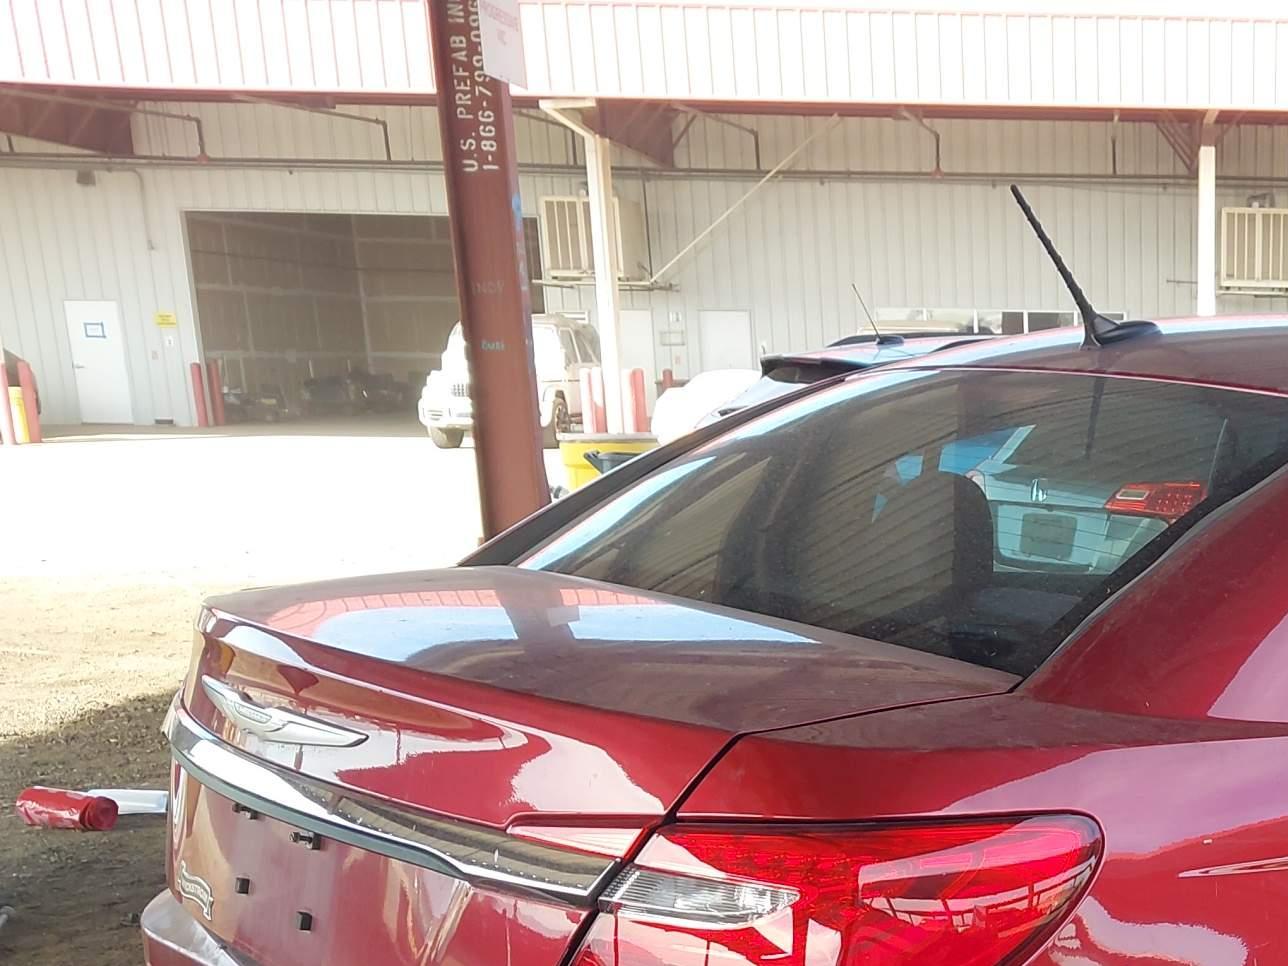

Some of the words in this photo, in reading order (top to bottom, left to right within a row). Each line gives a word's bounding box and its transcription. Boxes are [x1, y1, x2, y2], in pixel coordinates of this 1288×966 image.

[447, 0, 465, 23] IN
[450, 35, 474, 120] PREFAB
[461, 131, 479, 172] U.S.
